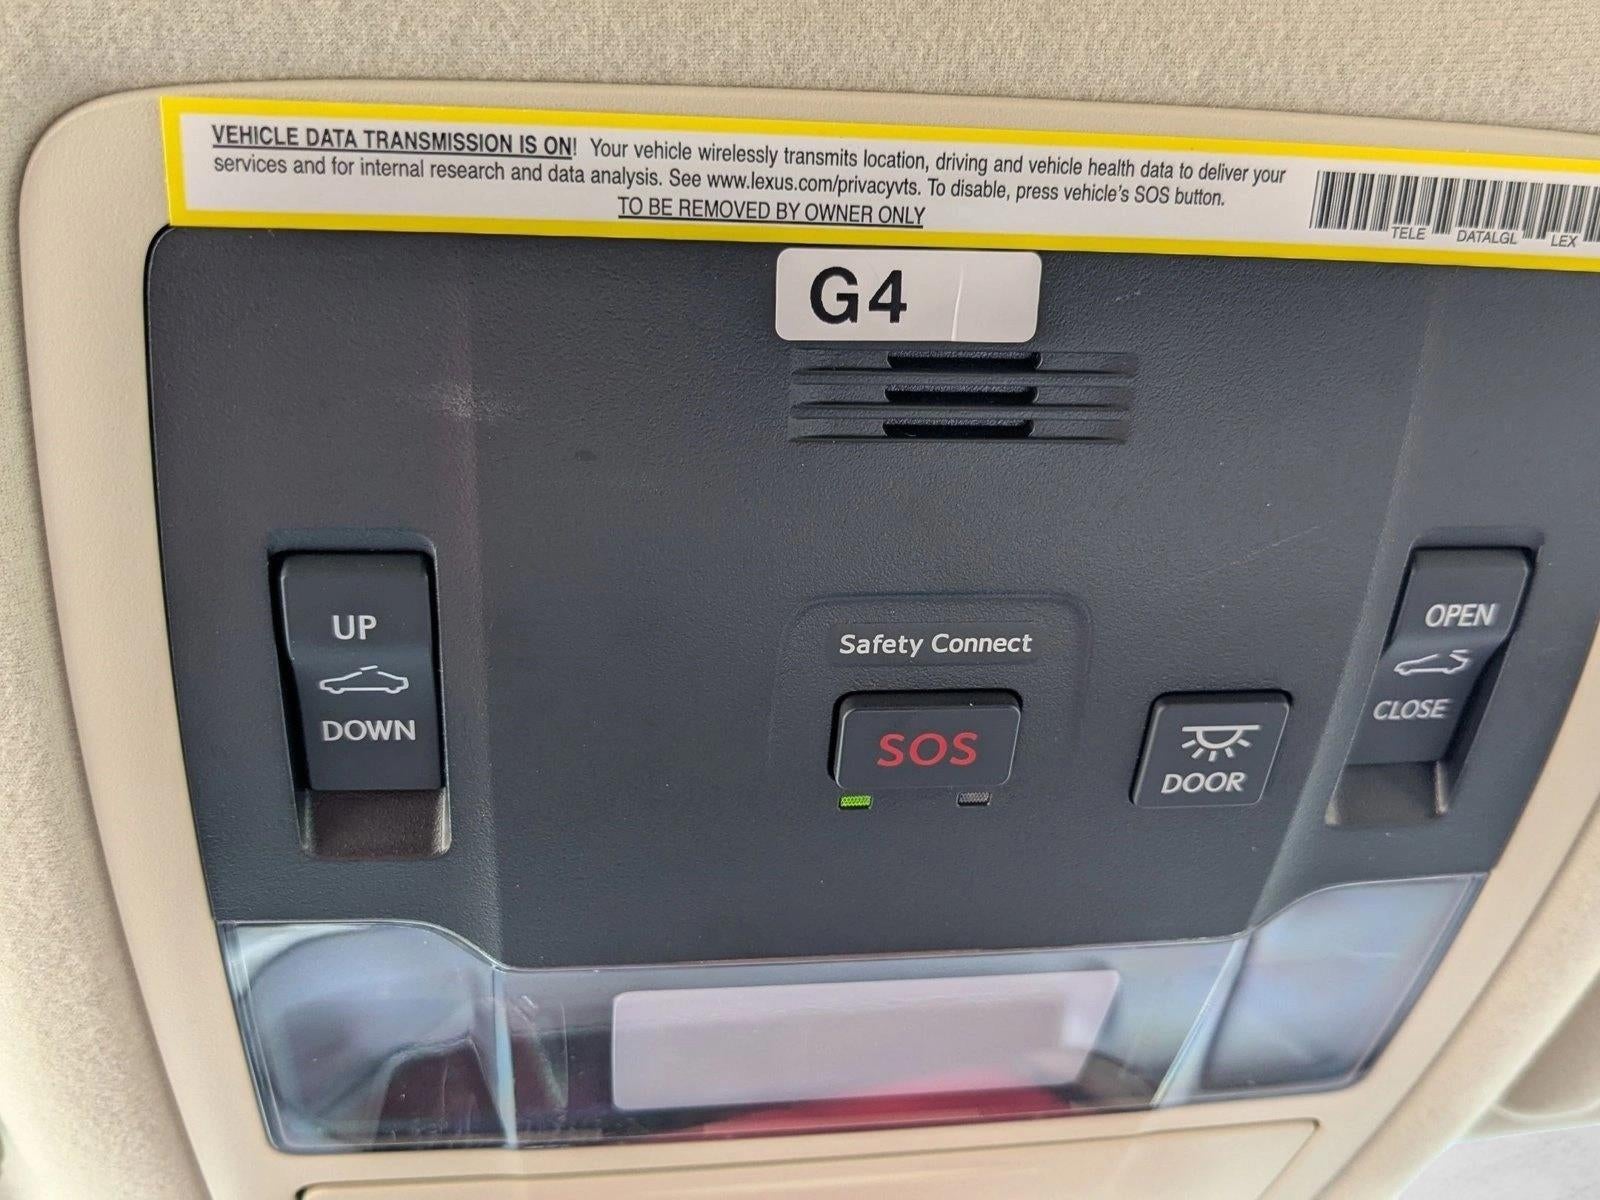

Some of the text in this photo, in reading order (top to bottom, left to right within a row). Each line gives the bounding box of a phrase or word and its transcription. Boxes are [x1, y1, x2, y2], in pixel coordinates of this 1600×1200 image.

[212, 124, 1286, 186] VEHICLE DATA TRANSMISSION IS ON! Your vehicle wirelessly transmits location, driving and vehicle health data to deliver your
[214, 156, 288, 175] services
[294, 157, 325, 175] and
[331, 158, 355, 175] for
[361, 159, 424, 178] internal
[430, 162, 506, 181] research
[511, 164, 543, 182] and
[549, 165, 585, 183] data
[591, 167, 663, 187] analysis.
[669, 170, 701, 187] See
[707, 171, 921, 198] www.lexus.com/privacyvts.
[928, 178, 946, 195] To
[951, 179, 1010, 201] disable,
[1015, 184, 1058, 202] press
[1135, 186, 1169, 205] SOS
[1175, 187, 1225, 206] button.
[618, 196, 926, 225] TO BE REMOVED BY OWNER ONLY
[1392, 227, 1577, 248] TELE DATALGL LEX
[809, 266, 908, 325] G4
[332, 615, 377, 640] UP
[1425, 603, 1496, 628] OPEN
[839, 634, 1032, 657] Safety Connect
[1373, 698, 1449, 721] CLOSE
[321, 719, 416, 741] DOWN
[877, 732, 978, 767] SOS
[1161, 772, 1247, 794] DOOR
